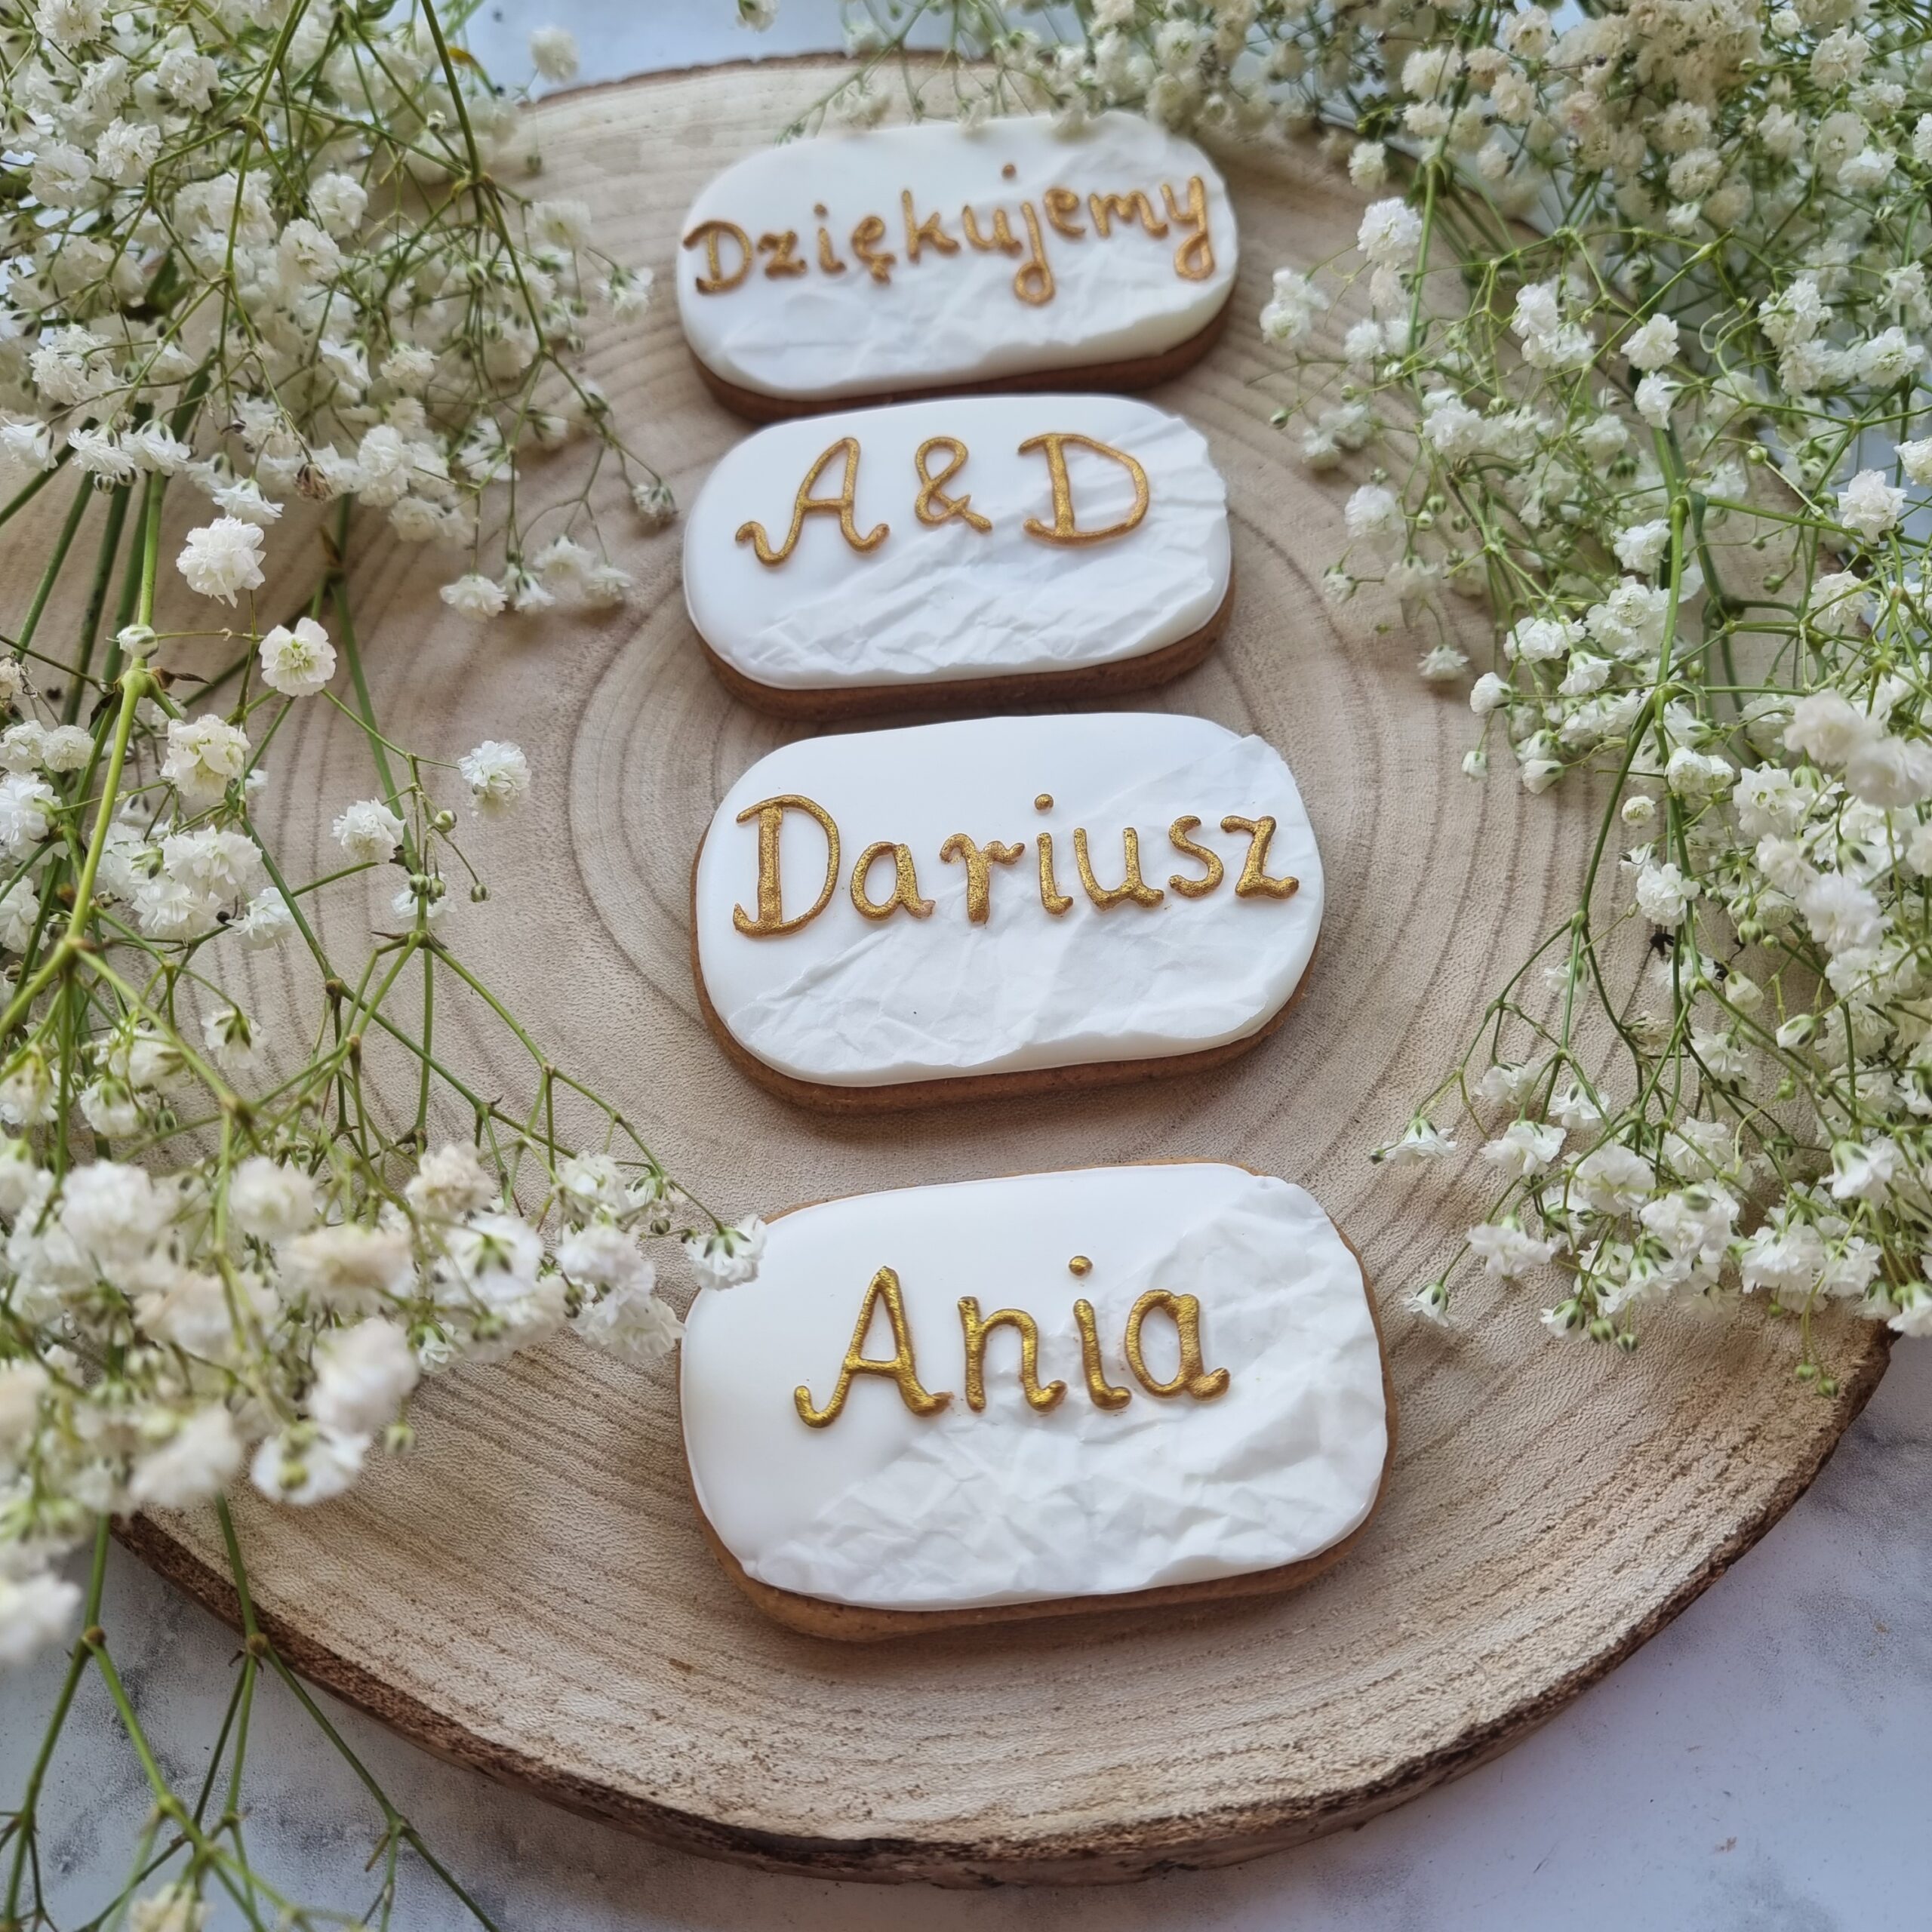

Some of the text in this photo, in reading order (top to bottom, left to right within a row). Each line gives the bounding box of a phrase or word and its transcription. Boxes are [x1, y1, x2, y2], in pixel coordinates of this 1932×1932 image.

[682, 162, 1215, 306] Dziękujemy
[735, 432, 1149, 568] A & D
[733, 794, 1300, 940] Dariusz
[793, 1256, 1230, 1429] Ania
